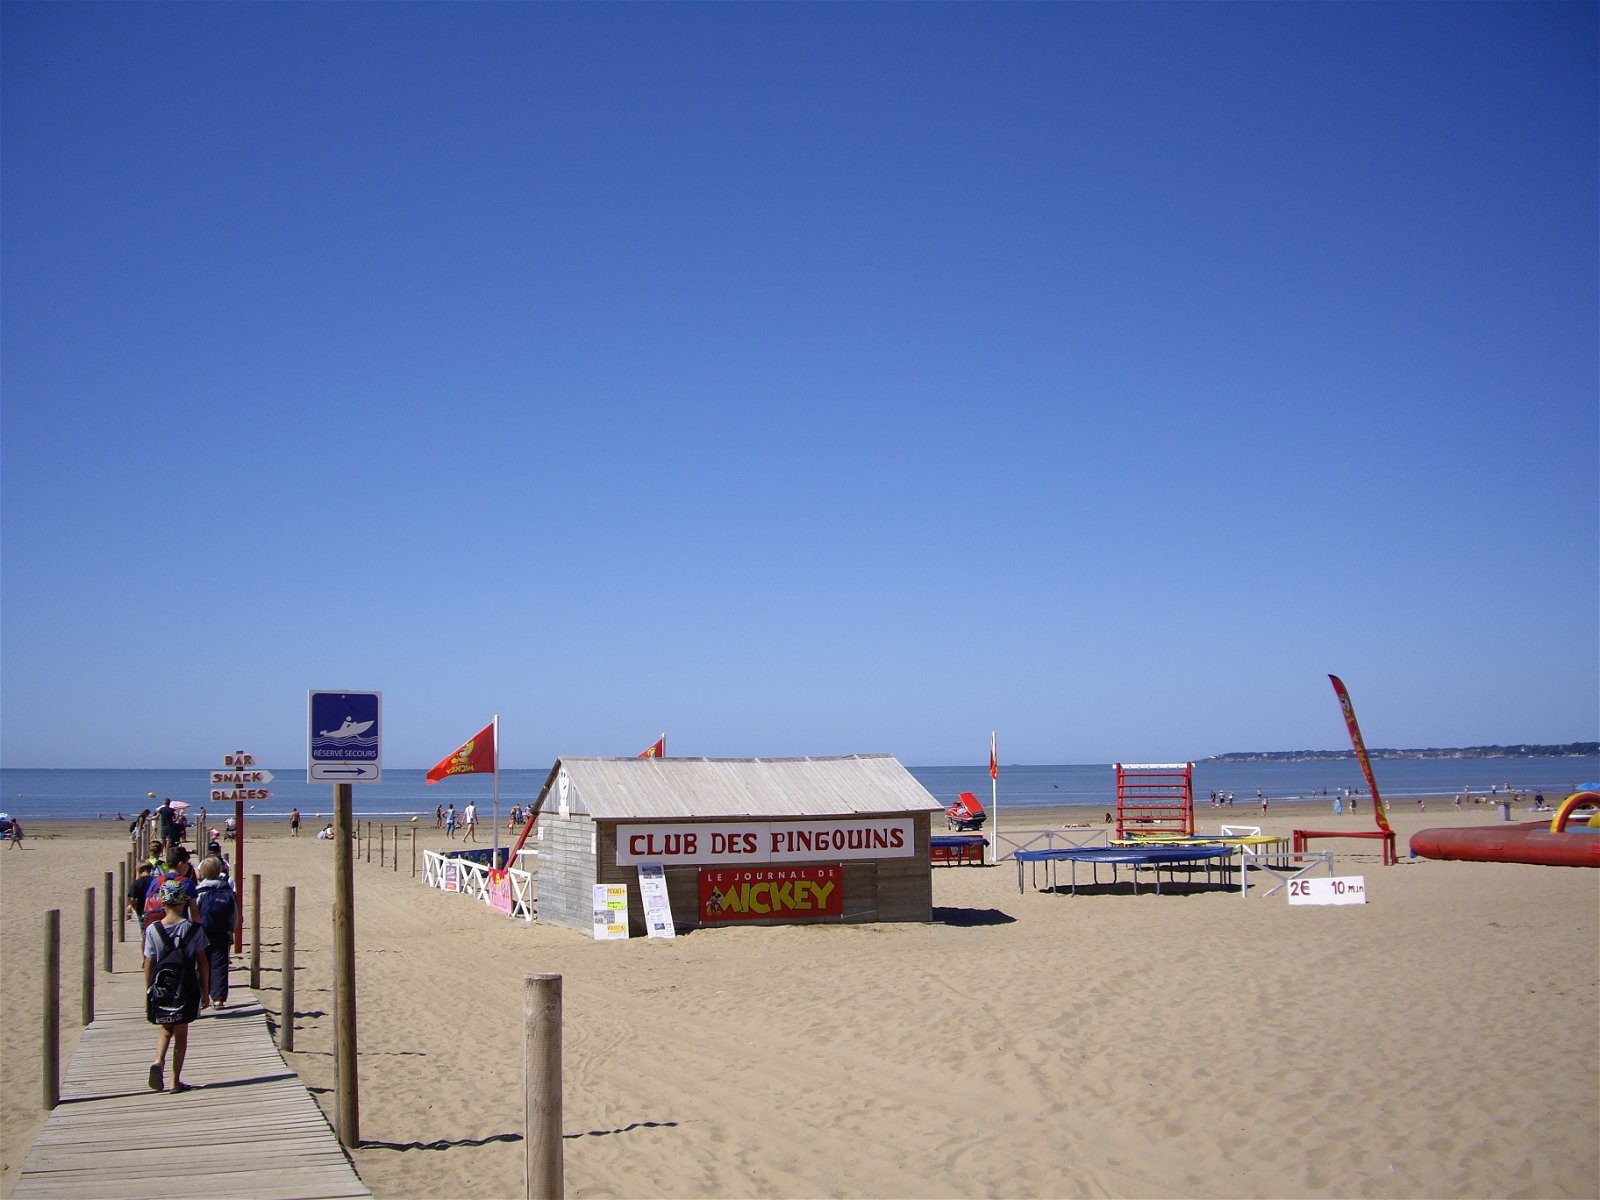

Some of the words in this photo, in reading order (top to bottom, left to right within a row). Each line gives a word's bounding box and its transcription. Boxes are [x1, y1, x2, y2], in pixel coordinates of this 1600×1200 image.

[313, 748, 344, 757] RÉSERVÉ
[345, 749, 376, 758] SECOURS
[224, 755, 252, 766] BAR
[212, 772, 262, 783] SNACK
[211, 789, 268, 801] GLACES
[629, 832, 698, 856] CLUB
[711, 832, 757, 854] DES
[770, 828, 904, 853] PINGOUINS
[707, 873, 722, 882] LE
[734, 870, 806, 881] JOURNAL
[818, 869, 834, 878] DE
[1331, 880, 1345, 895] 10
[711, 880, 836, 914] MICKEY
